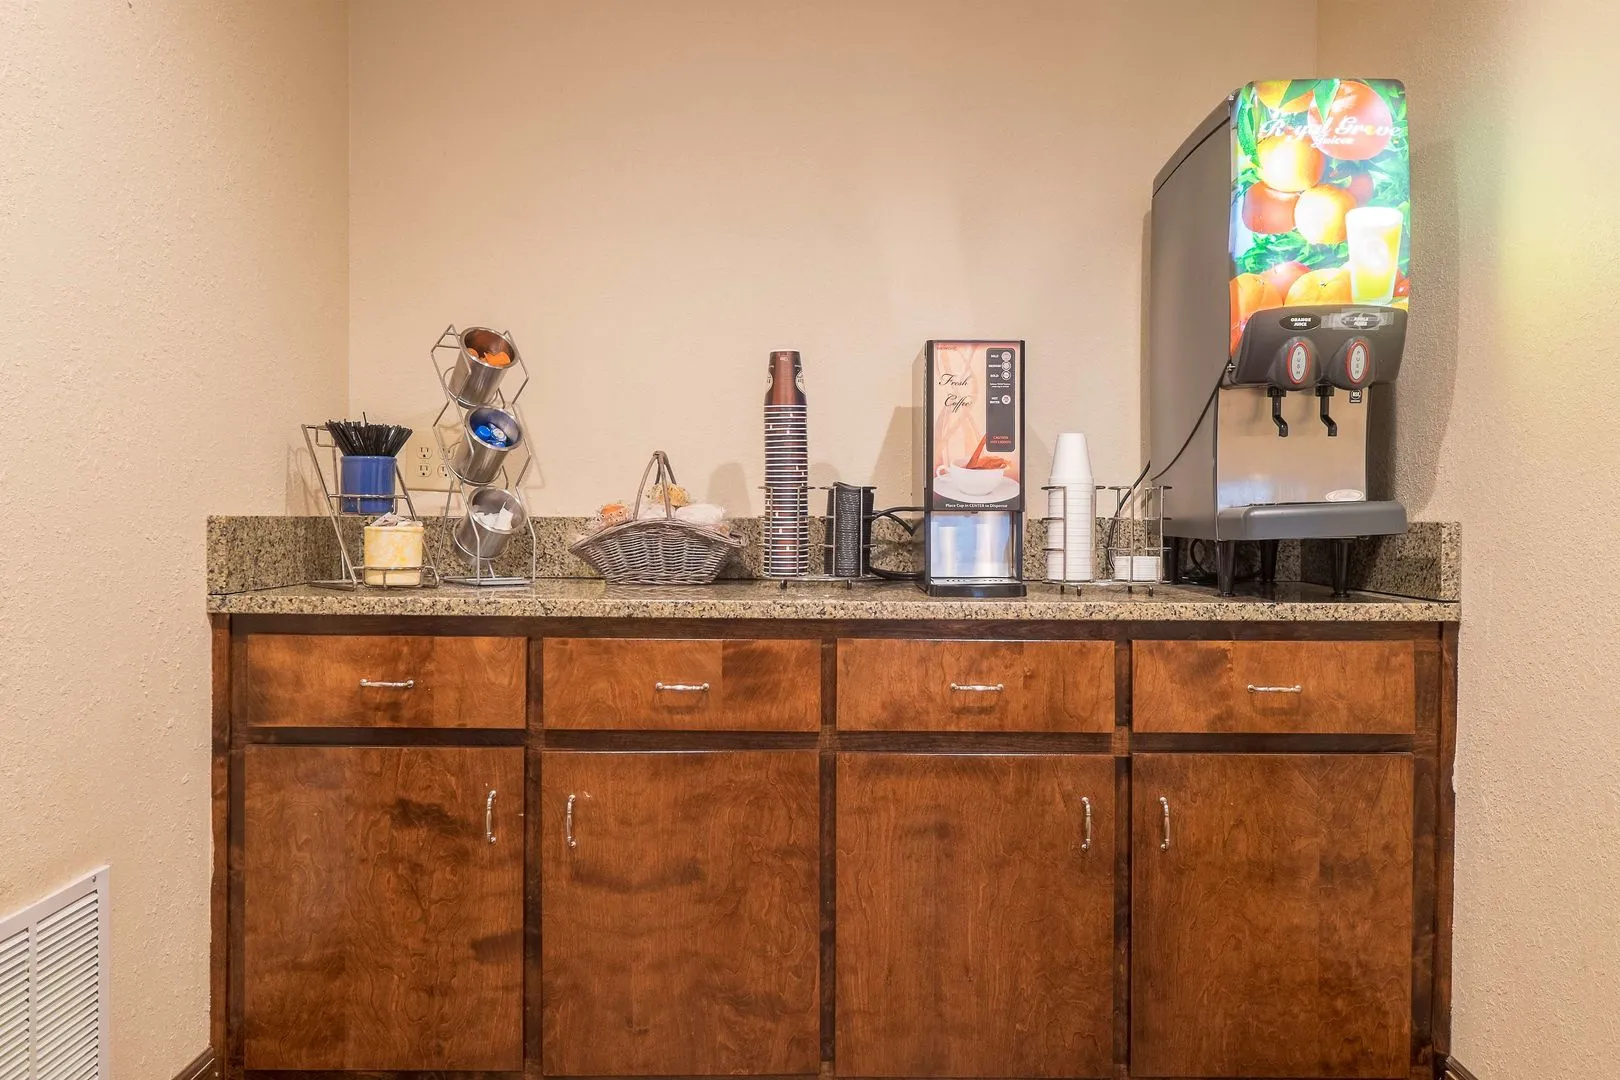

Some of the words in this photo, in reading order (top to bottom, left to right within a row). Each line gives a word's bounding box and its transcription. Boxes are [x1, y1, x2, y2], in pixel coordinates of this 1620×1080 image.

[1258, 117, 1332, 140] Royal
[1336, 116, 1401, 136] Grove
[938, 373, 970, 386] Fresh
[944, 394, 972, 414] Coffee
